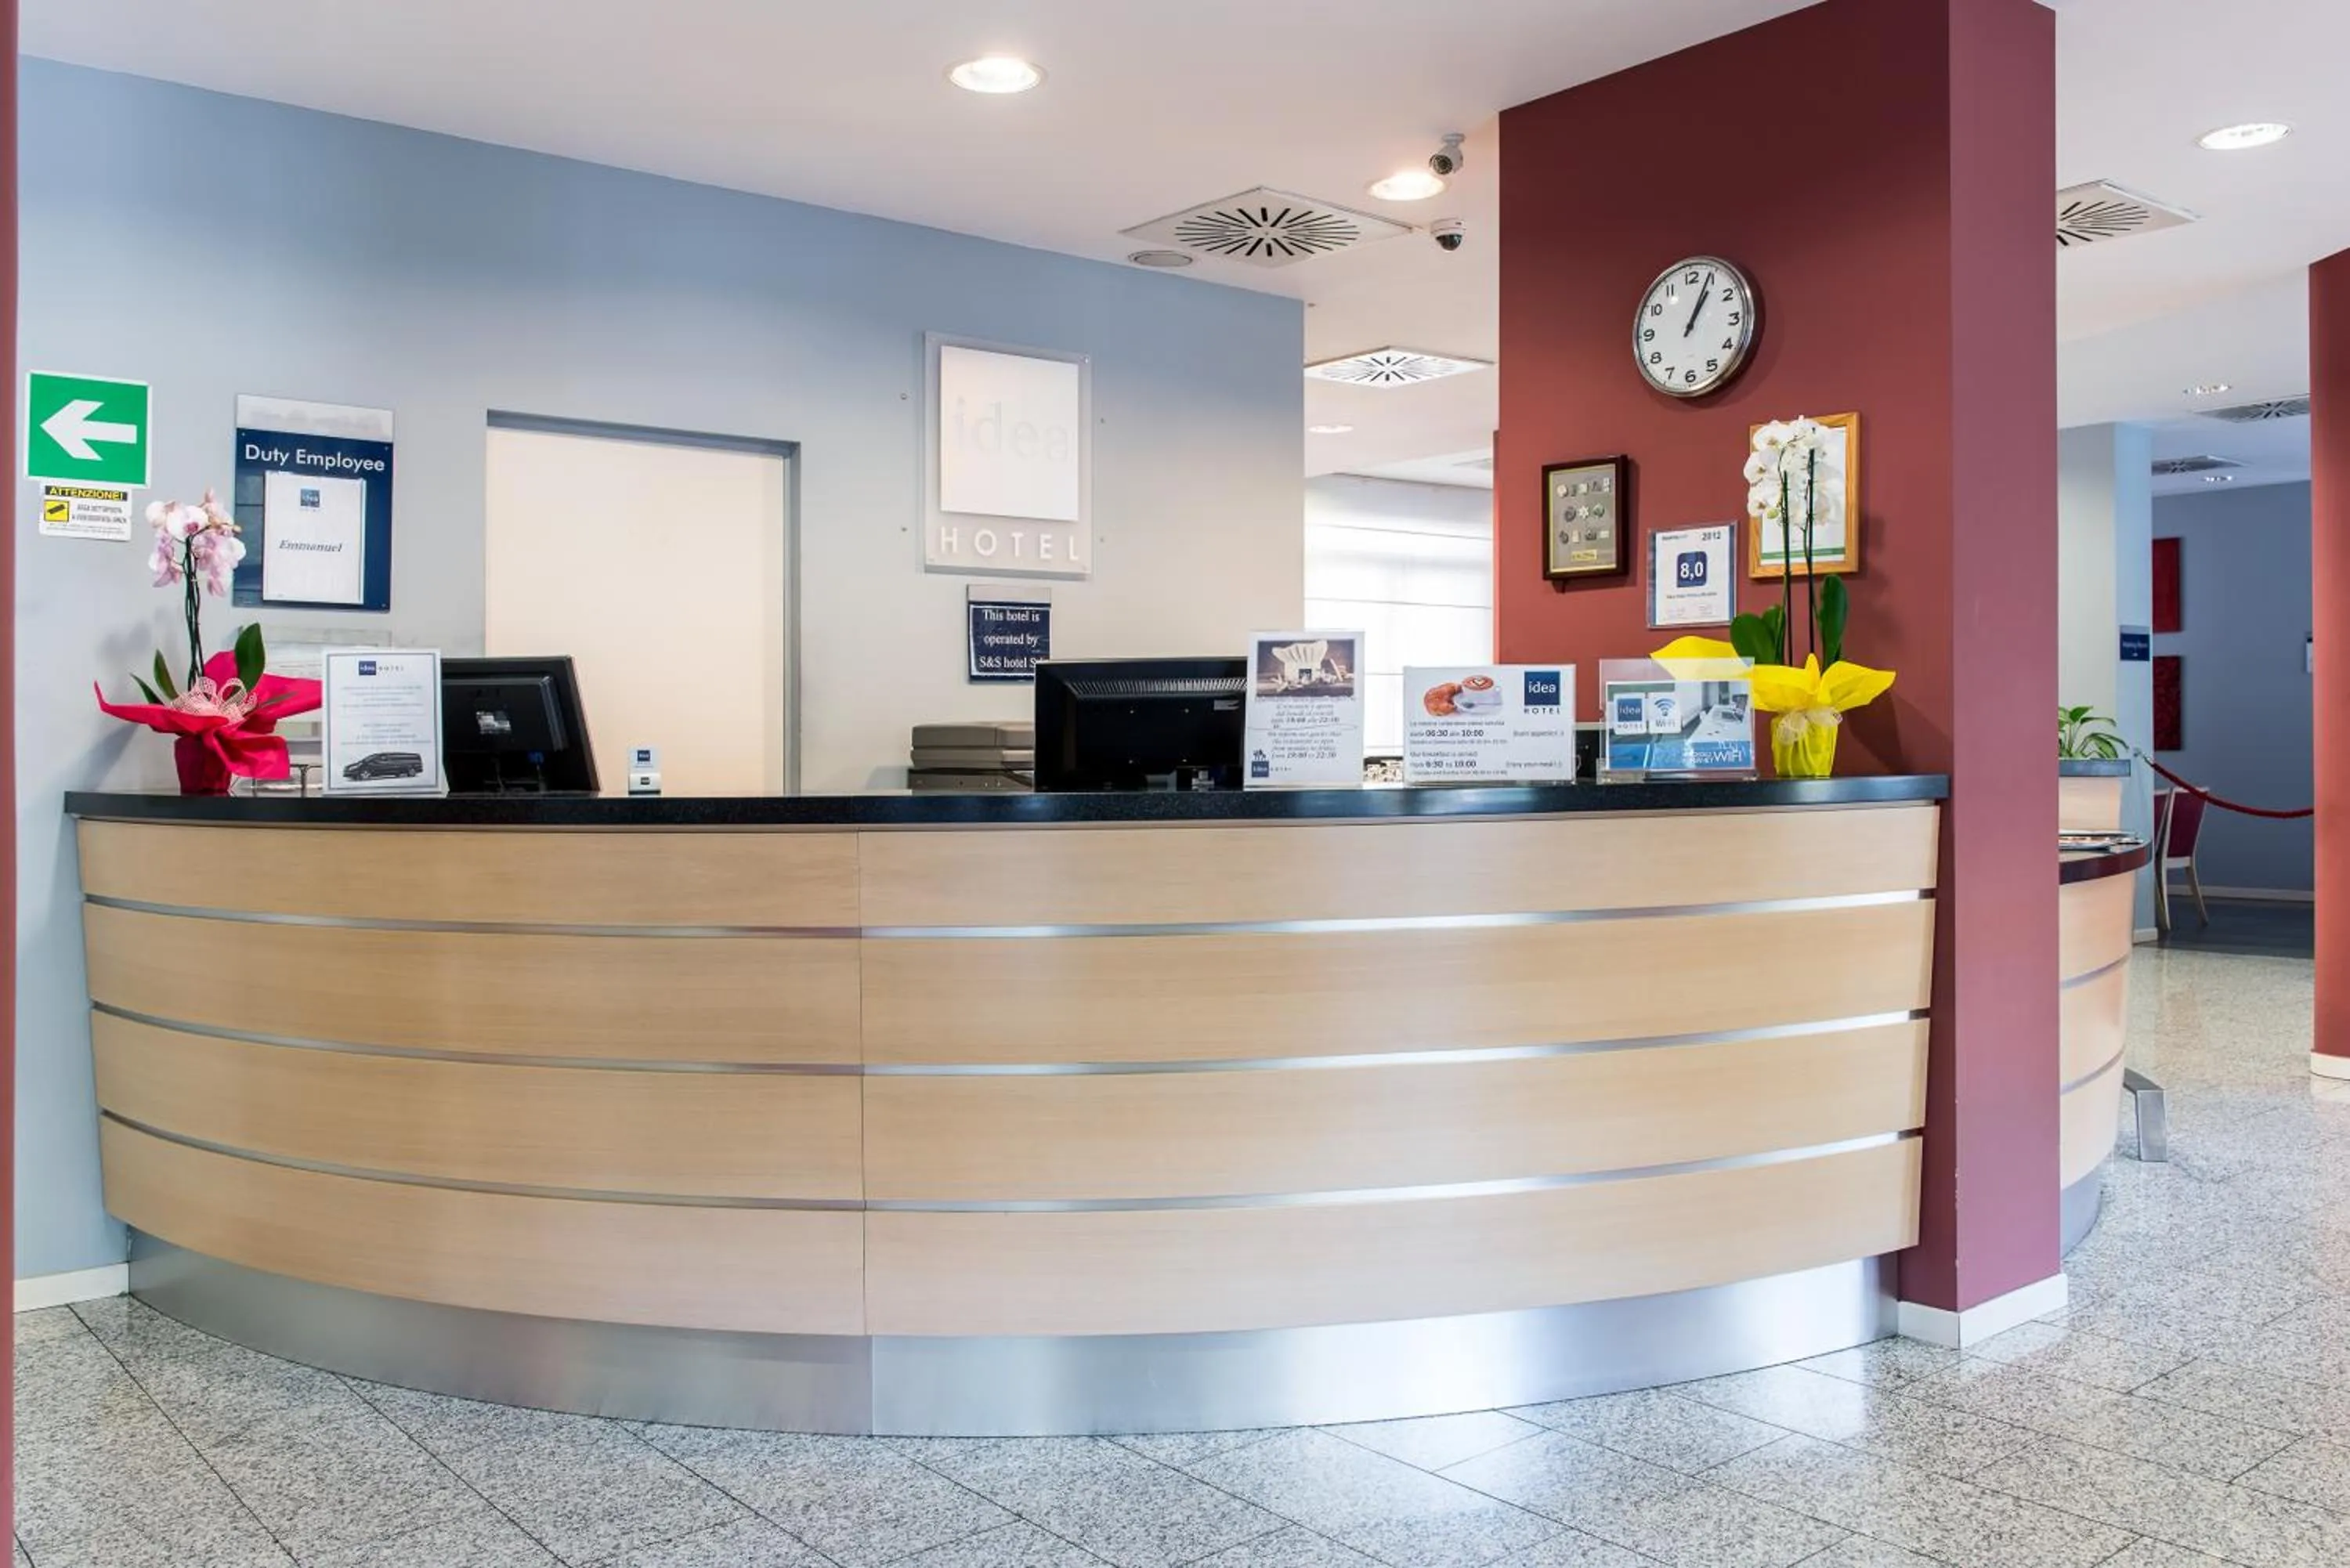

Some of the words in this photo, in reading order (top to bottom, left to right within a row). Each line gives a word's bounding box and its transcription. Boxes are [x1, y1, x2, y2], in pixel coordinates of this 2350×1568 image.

[1685, 271, 1699, 285] 12
[1666, 284, 1674, 298] 11
[1723, 288, 1734, 302] 2
[1650, 303, 1662, 316] 10
[1728, 312, 1740, 326] 3
[1643, 329, 1655, 341] 9
[1722, 338, 1734, 350] 4
[1650, 352, 1661, 364] 8
[1706, 359, 1718, 372] 5
[1665, 367, 1675, 380] 7
[1685, 370, 1696, 382] 6
[952, 396, 1072, 464] idea
[244, 443, 290, 466] Duty
[296, 448, 385, 473] Employee
[49, 486, 123, 500] ATTENZIONE!
[1701, 530, 1721, 541] 2012
[279, 540, 343, 553] Emmanuel
[941, 526, 1079, 562] HOTEL
[1679, 561, 1704, 580] 8,0
[982, 609, 1003, 621] This
[1006, 609, 1029, 621] hotel
[1032, 610, 1040, 622] is
[983, 633, 1024, 647] operated
[1026, 634, 1039, 647] by
[979, 656, 1002, 668] S&S
[1003, 656, 1027, 668] hotel
[1528, 681, 1556, 693] idea
[1618, 705, 1641, 714] idea
